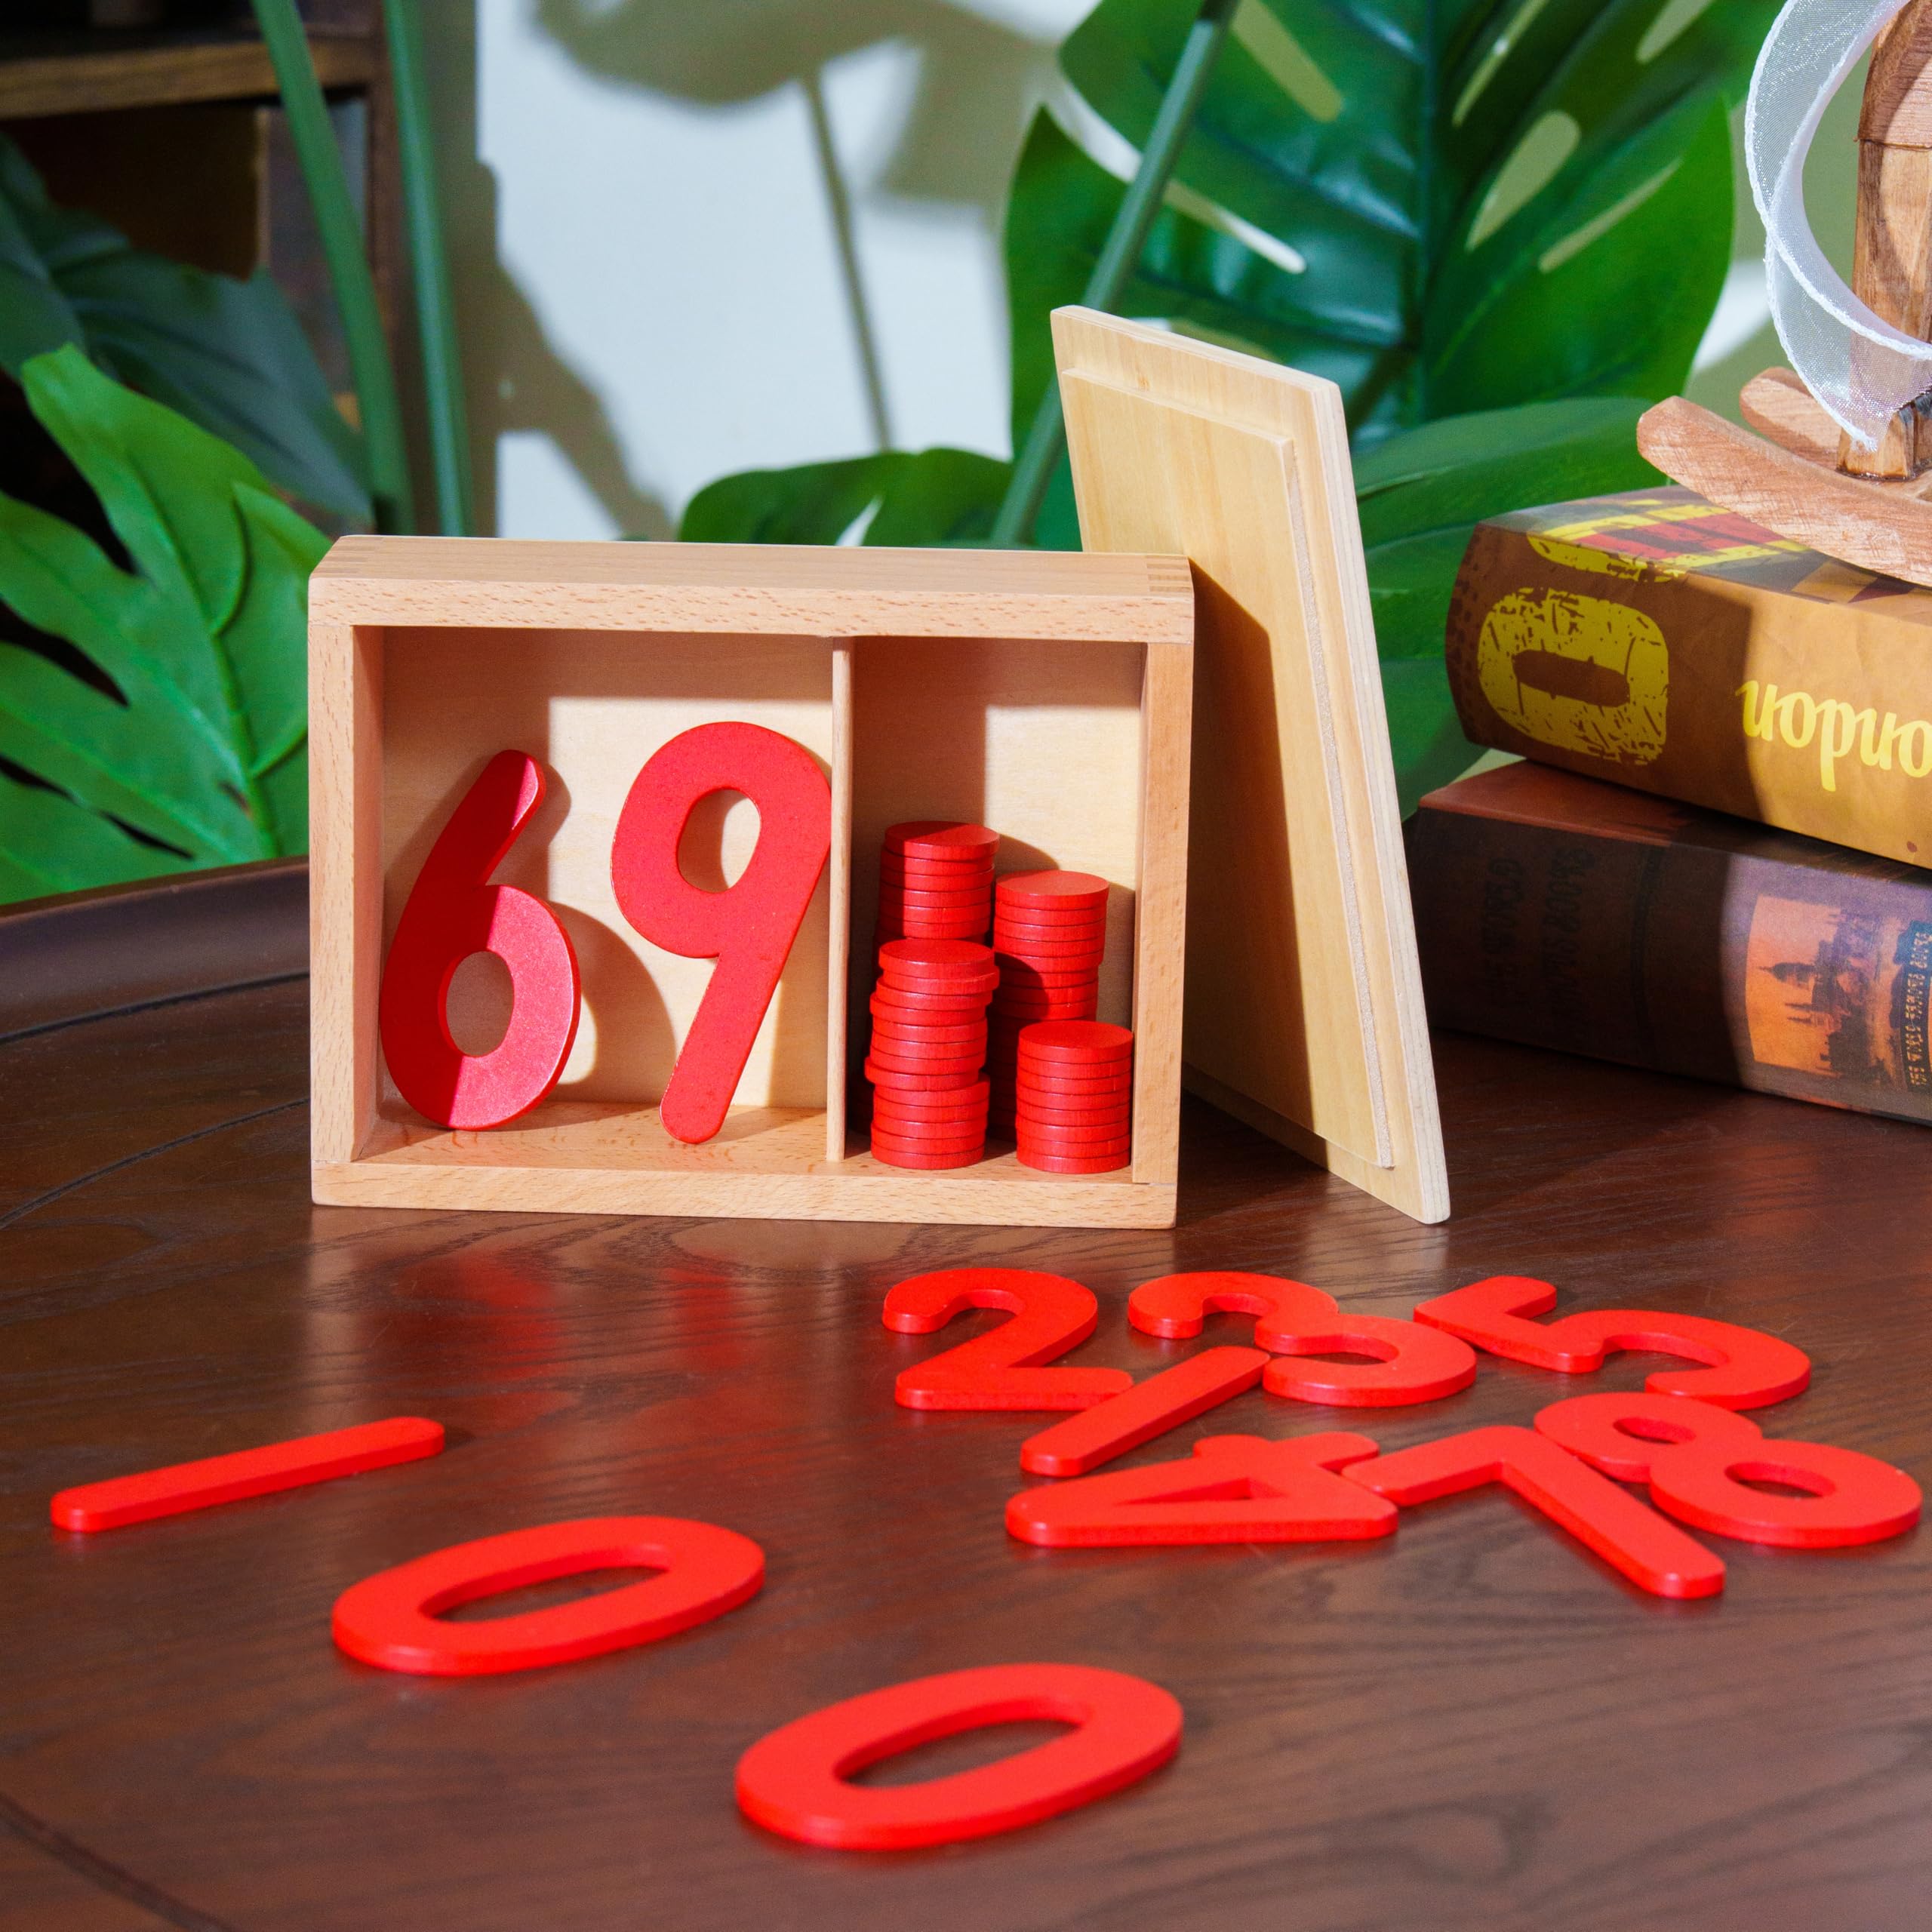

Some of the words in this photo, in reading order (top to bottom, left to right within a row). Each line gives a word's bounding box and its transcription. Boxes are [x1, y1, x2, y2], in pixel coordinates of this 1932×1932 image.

[1736, 680, 1932, 792] ondon
[881, 1267, 1134, 1411] 2
[1128, 1270, 1476, 1407] 3
[1414, 1275, 1811, 1410] 5
[1006, 1432, 1398, 1546] 4
[1343, 1426, 1725, 1598] 7
[1534, 1392, 1921, 1546] 8
